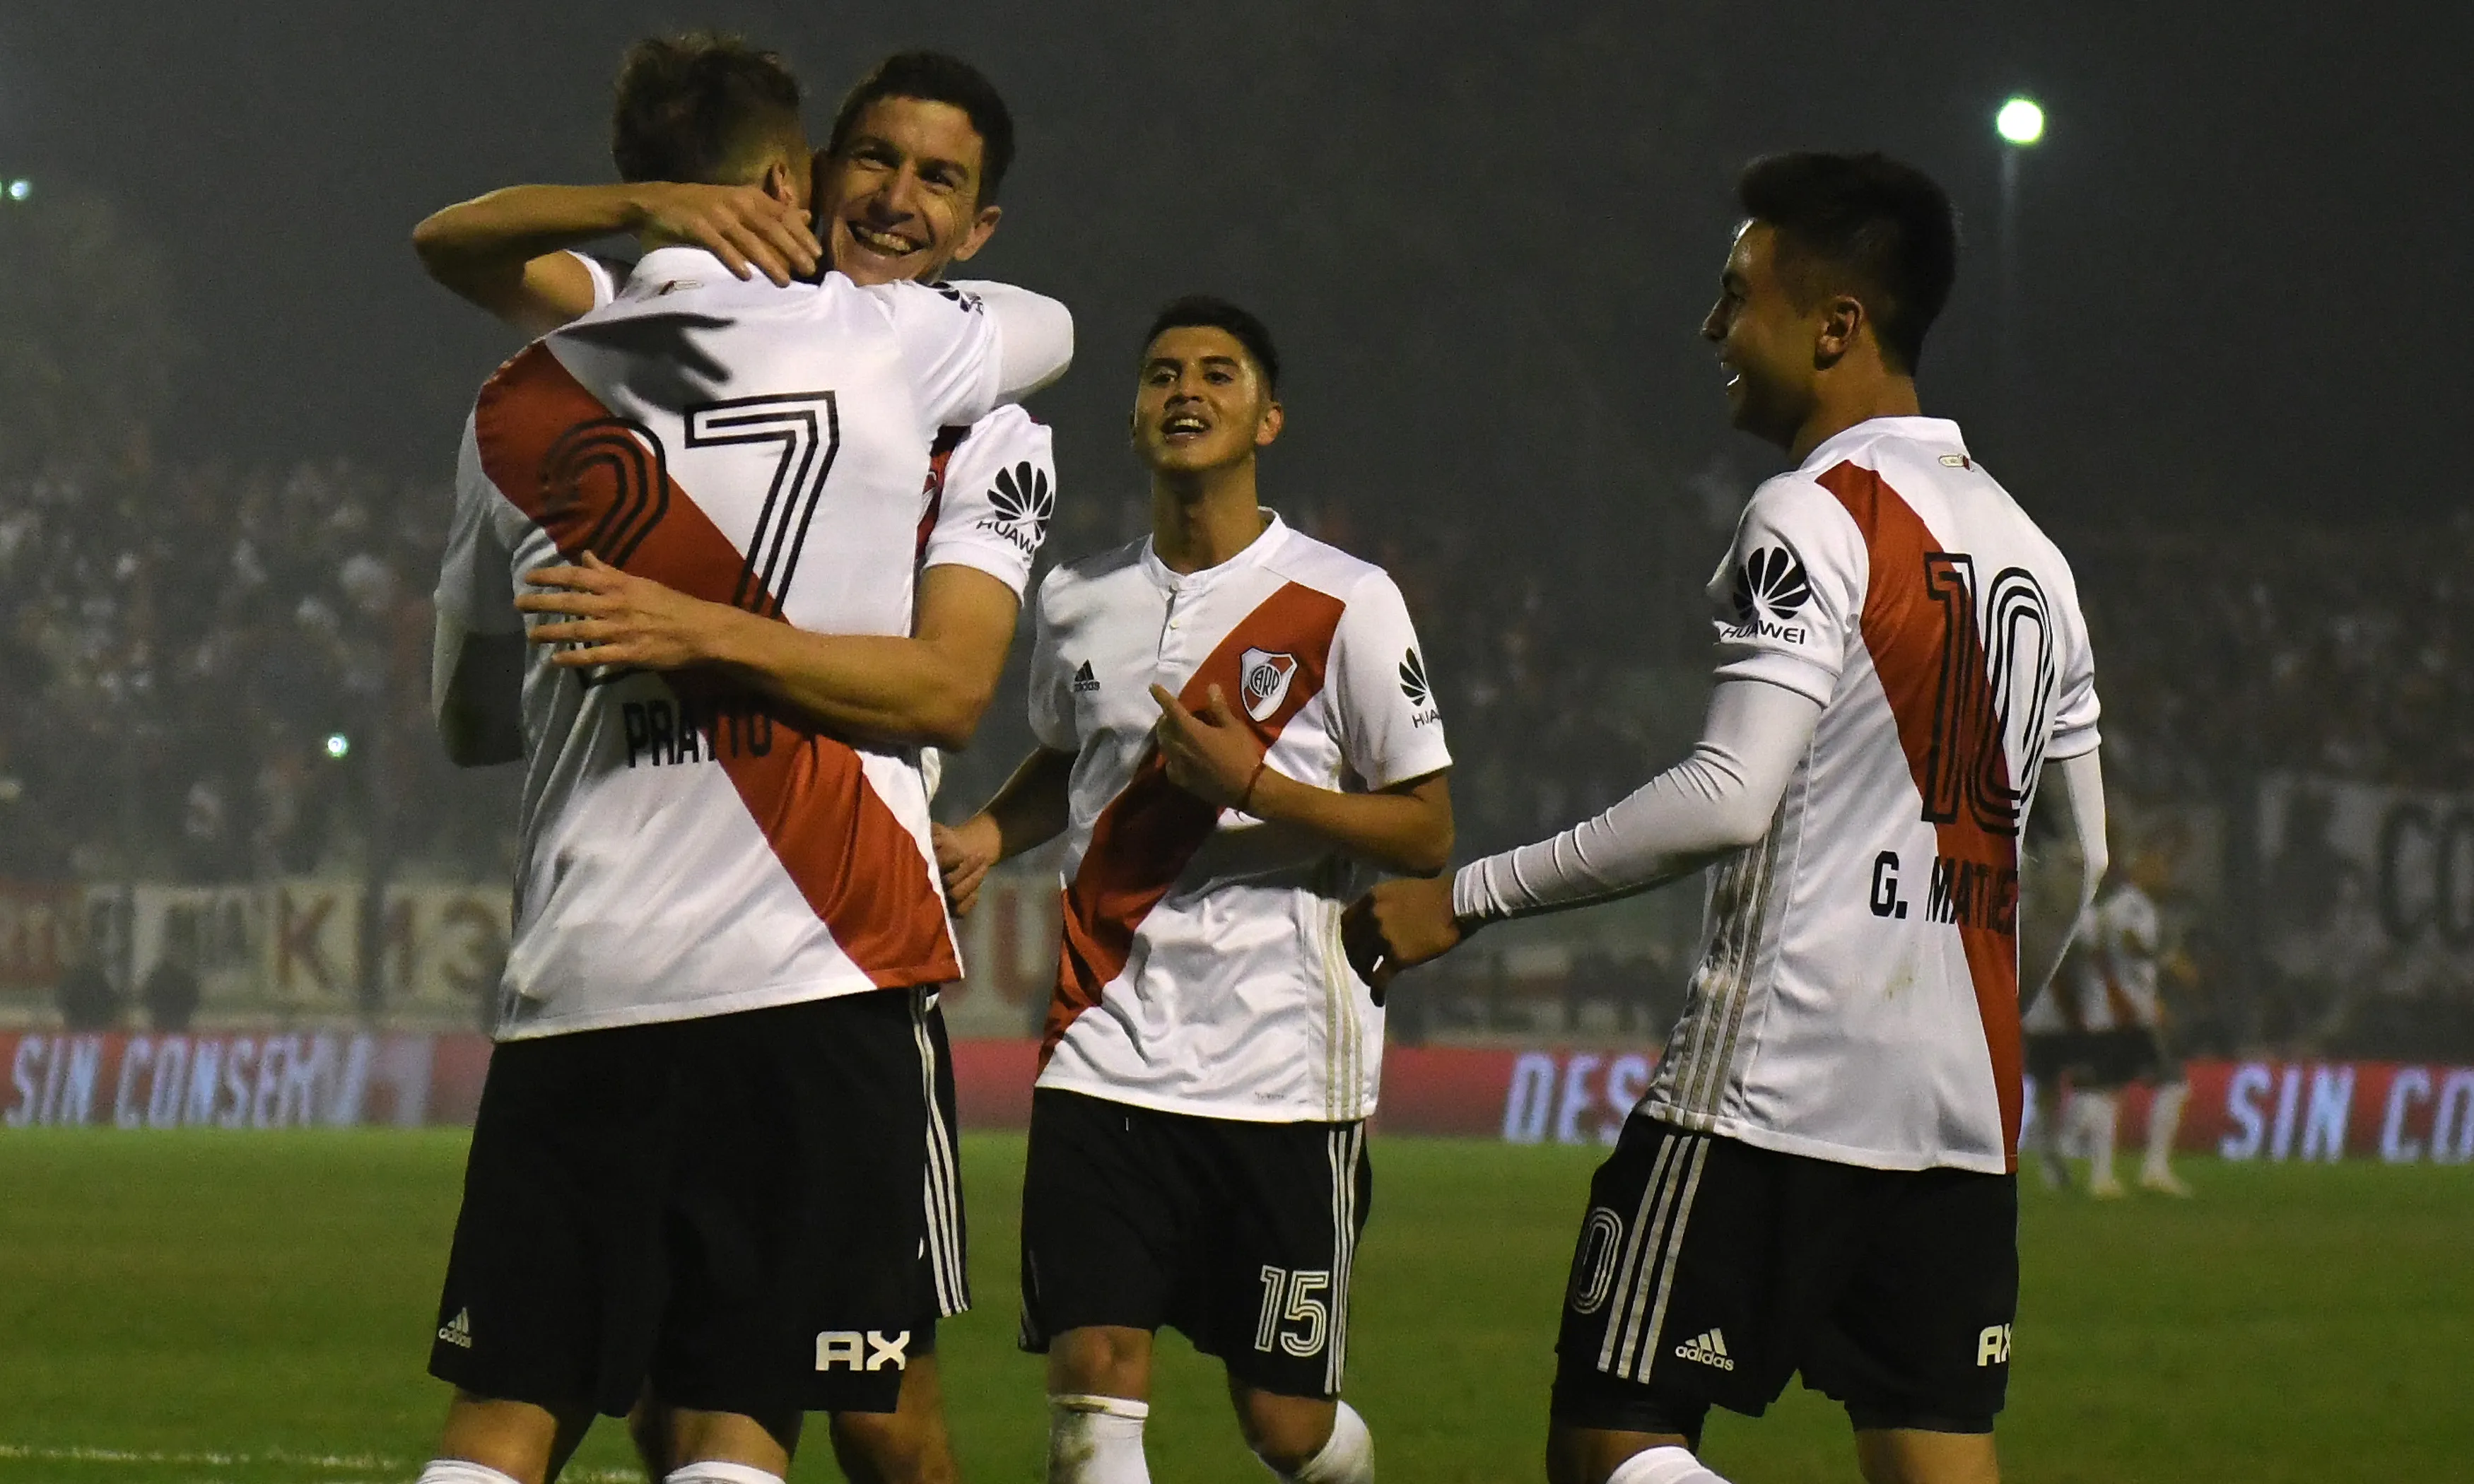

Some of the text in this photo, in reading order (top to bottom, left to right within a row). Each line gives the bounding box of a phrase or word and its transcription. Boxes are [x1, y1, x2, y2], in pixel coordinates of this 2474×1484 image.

[1721, 619, 1806, 645] HUAWEI
[1921, 551, 2055, 837] 10
[1870, 850, 1908, 919] G.
[4, 1034, 104, 1128] SIN
[2220, 1061, 2356, 1161] SIN
[814, 1330, 910, 1371] AX
[1254, 1264, 1330, 1357] 15
[1675, 1345, 1735, 1372] adidas
